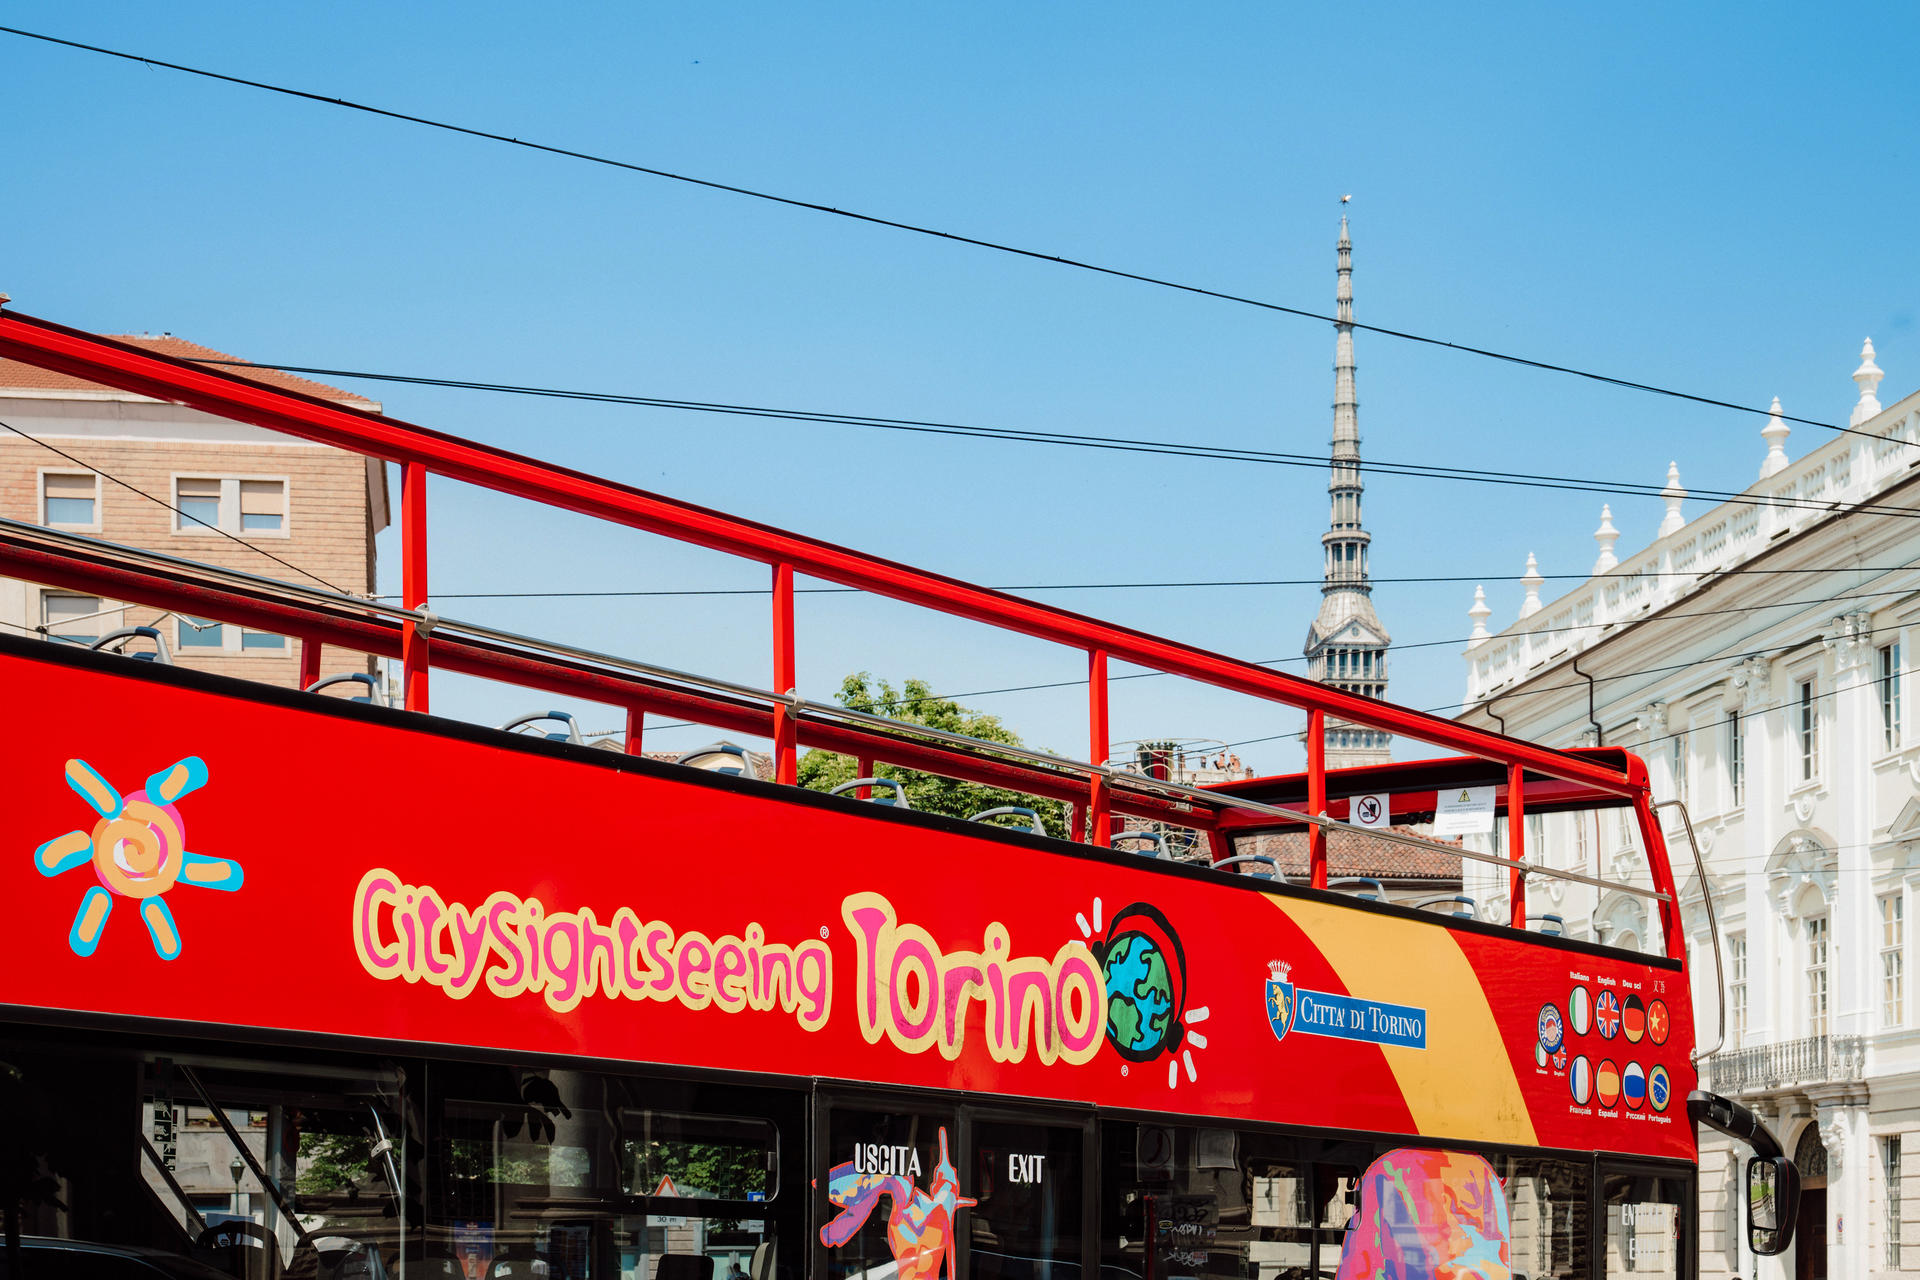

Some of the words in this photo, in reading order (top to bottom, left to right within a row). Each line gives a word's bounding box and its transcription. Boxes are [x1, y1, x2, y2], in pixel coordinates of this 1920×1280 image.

[841, 891, 1108, 1066] Torino
[1598, 975, 1616, 985] English
[1349, 1009, 1366, 1031] DI
[1368, 1006, 1422, 1039] TORINO
[1569, 1105, 1592, 1116] Français
[1598, 1108, 1619, 1119] Español
[854, 1142, 922, 1177] USCITA
[1008, 1153, 1046, 1184] EXIT
